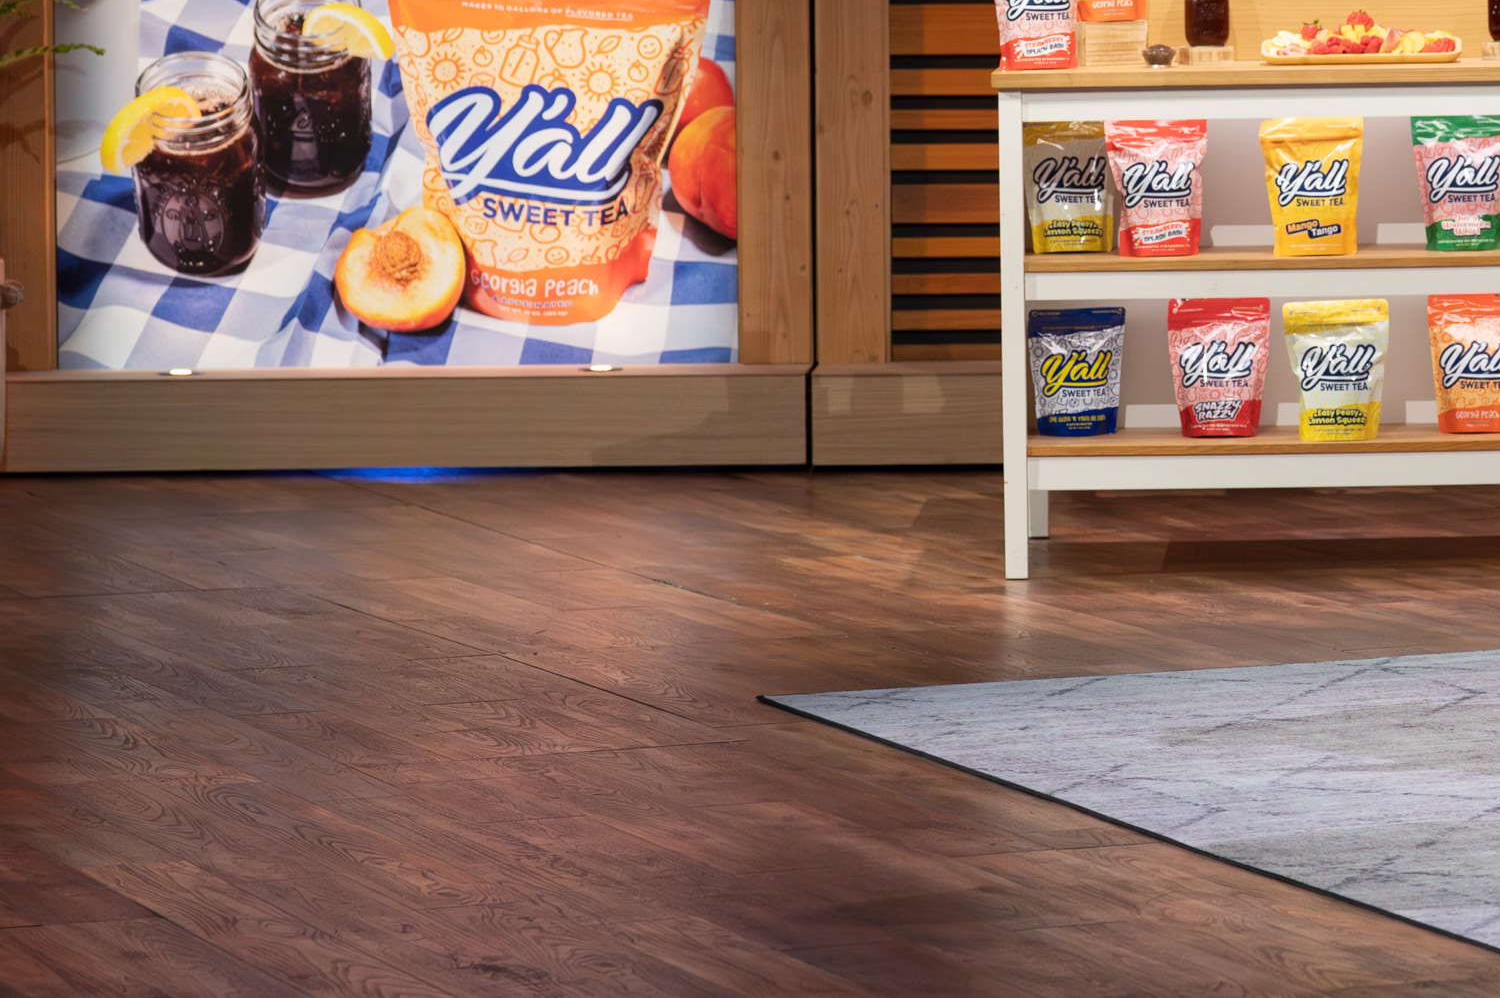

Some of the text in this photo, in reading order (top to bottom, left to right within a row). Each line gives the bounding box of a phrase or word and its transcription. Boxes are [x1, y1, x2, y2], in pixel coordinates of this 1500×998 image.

[427, 85, 661, 204] Y'all
[1033, 156, 1106, 204] Y'all
[1122, 160, 1195, 209] Y'all
[1275, 159, 1349, 207] Y'all
[1055, 195, 1084, 203] SWEET
[1143, 199, 1190, 208] SWEET TEA
[1296, 198, 1345, 207] SWEET TEA
[1480, 194, 1495, 202] TEA
[482, 198, 629, 226] SWEET TEA
[1287, 220, 1318, 232] Mango
[1311, 225, 1339, 237] Tango
[471, 269, 599, 298] Georgia Peach
[1180, 340, 1256, 388] Y'all
[1300, 344, 1376, 391] Y'all
[1041, 350, 1112, 398] Y'all
[1094, 388, 1106, 396] TEA
[1320, 382, 1368, 391] SWEET TEA
[1194, 401, 1242, 412] SNAZZY
[1198, 410, 1238, 421] RAZZY
[1317, 409, 1359, 417] Easy Peasy
